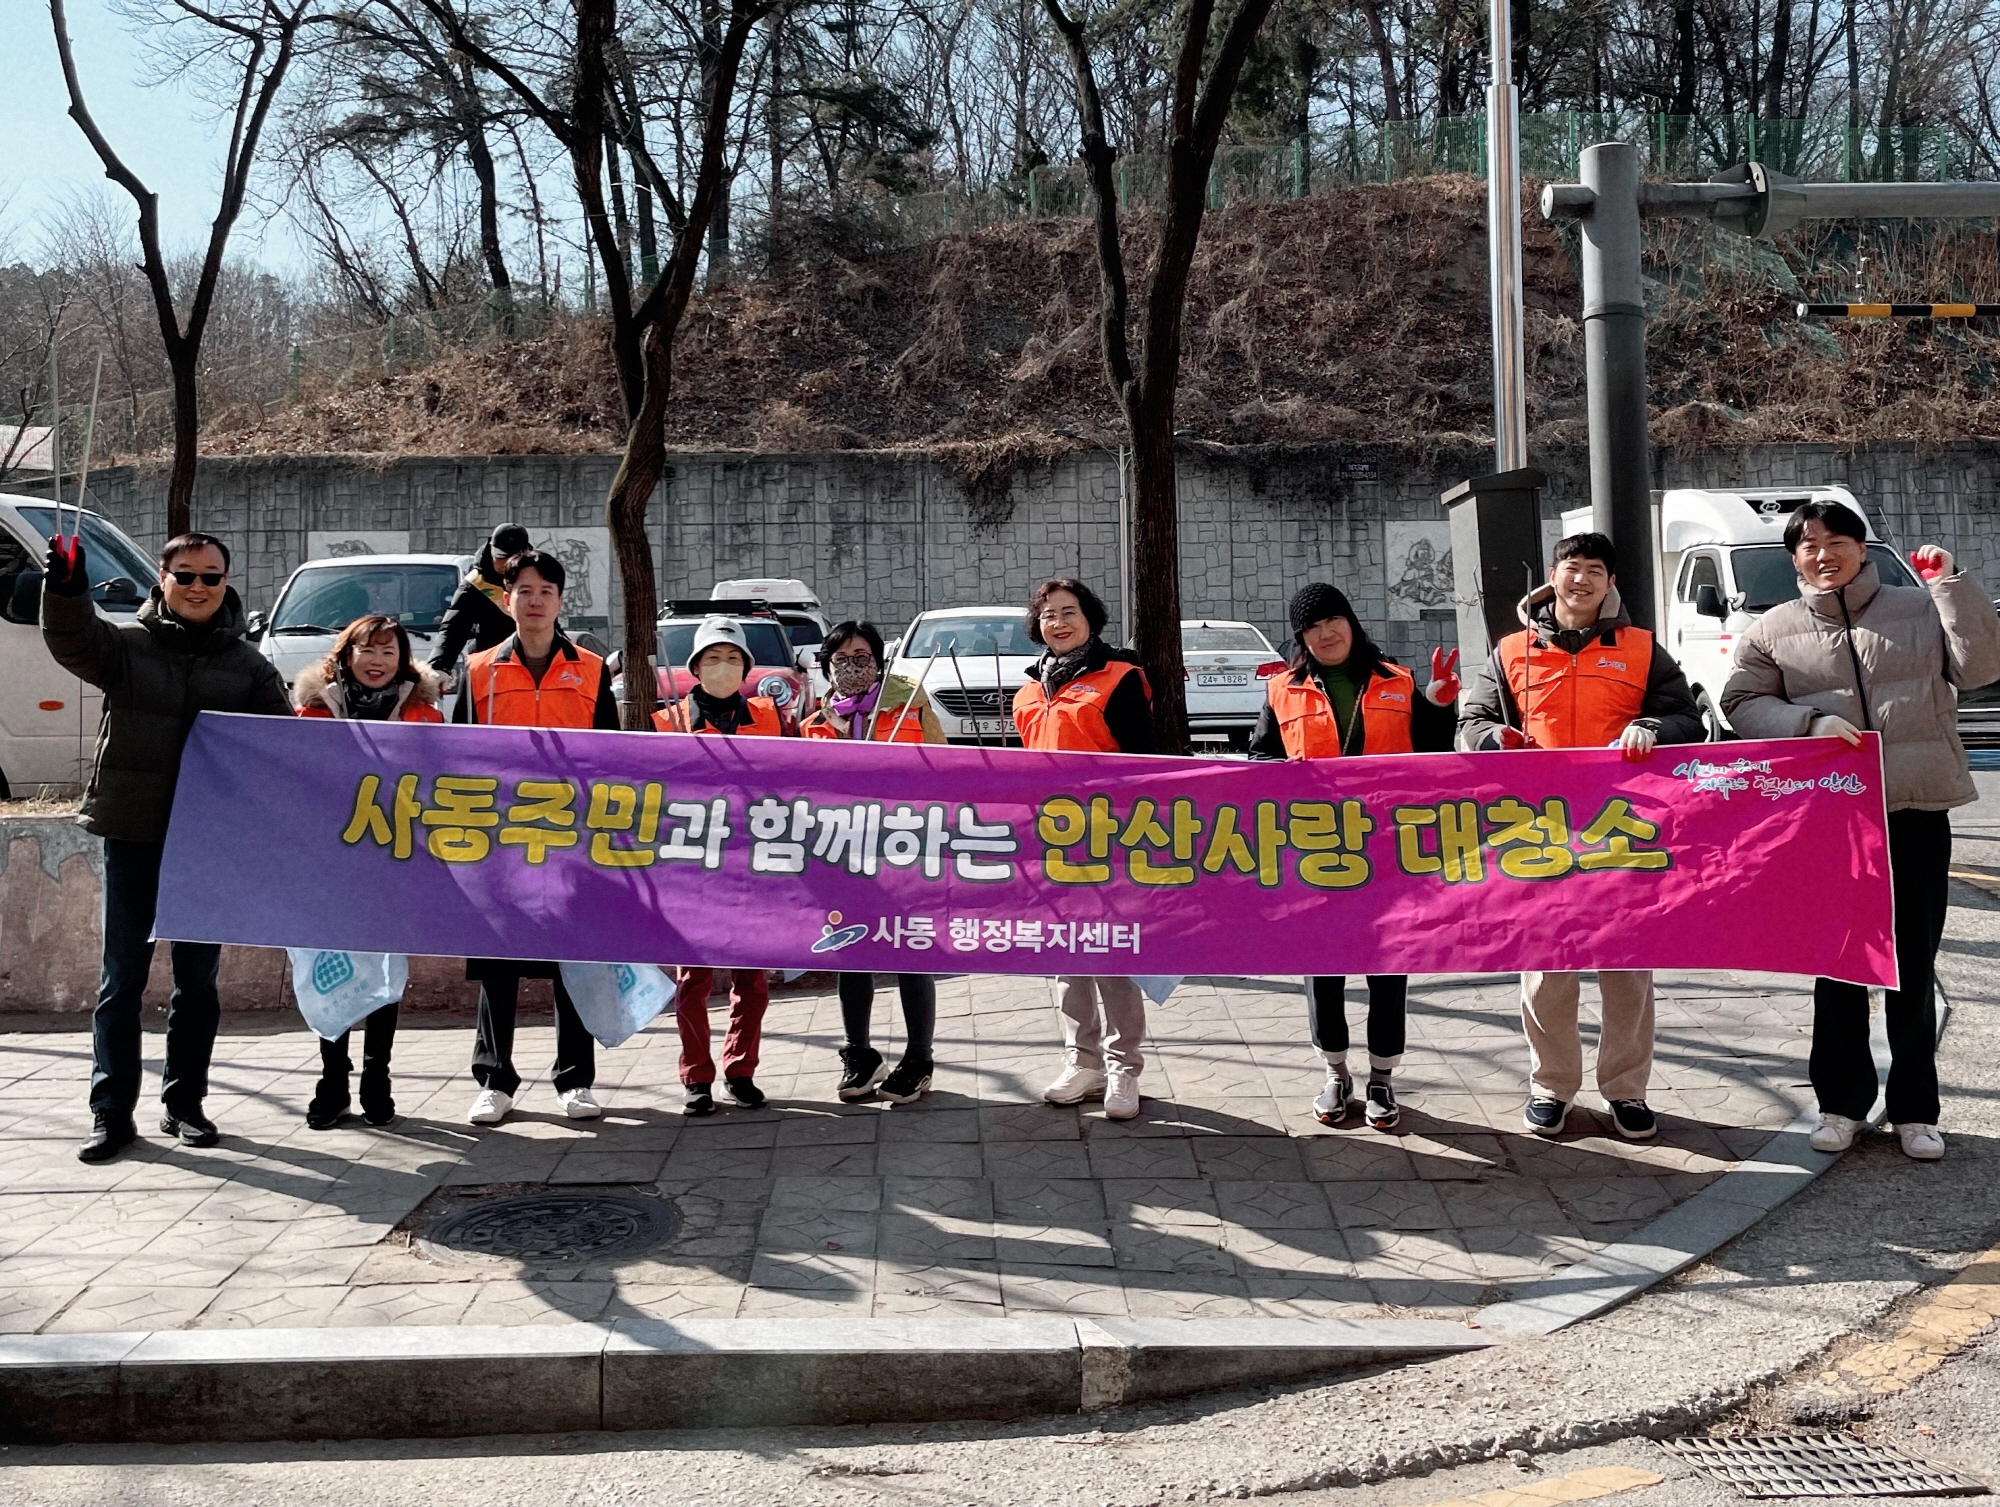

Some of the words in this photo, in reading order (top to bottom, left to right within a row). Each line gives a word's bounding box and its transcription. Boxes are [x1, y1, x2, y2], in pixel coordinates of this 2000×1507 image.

[994, 720, 1016, 732] 375
[1817, 771, 1868, 796] 안산
[341, 772, 733, 871] 사동주민과
[748, 797, 1018, 881] 함께하는
[1036, 796, 1375, 889] 안산사랑
[1393, 797, 1671, 883] 대청소
[871, 915, 937, 950] 사동
[947, 916, 1141, 955] 행정복지센터
